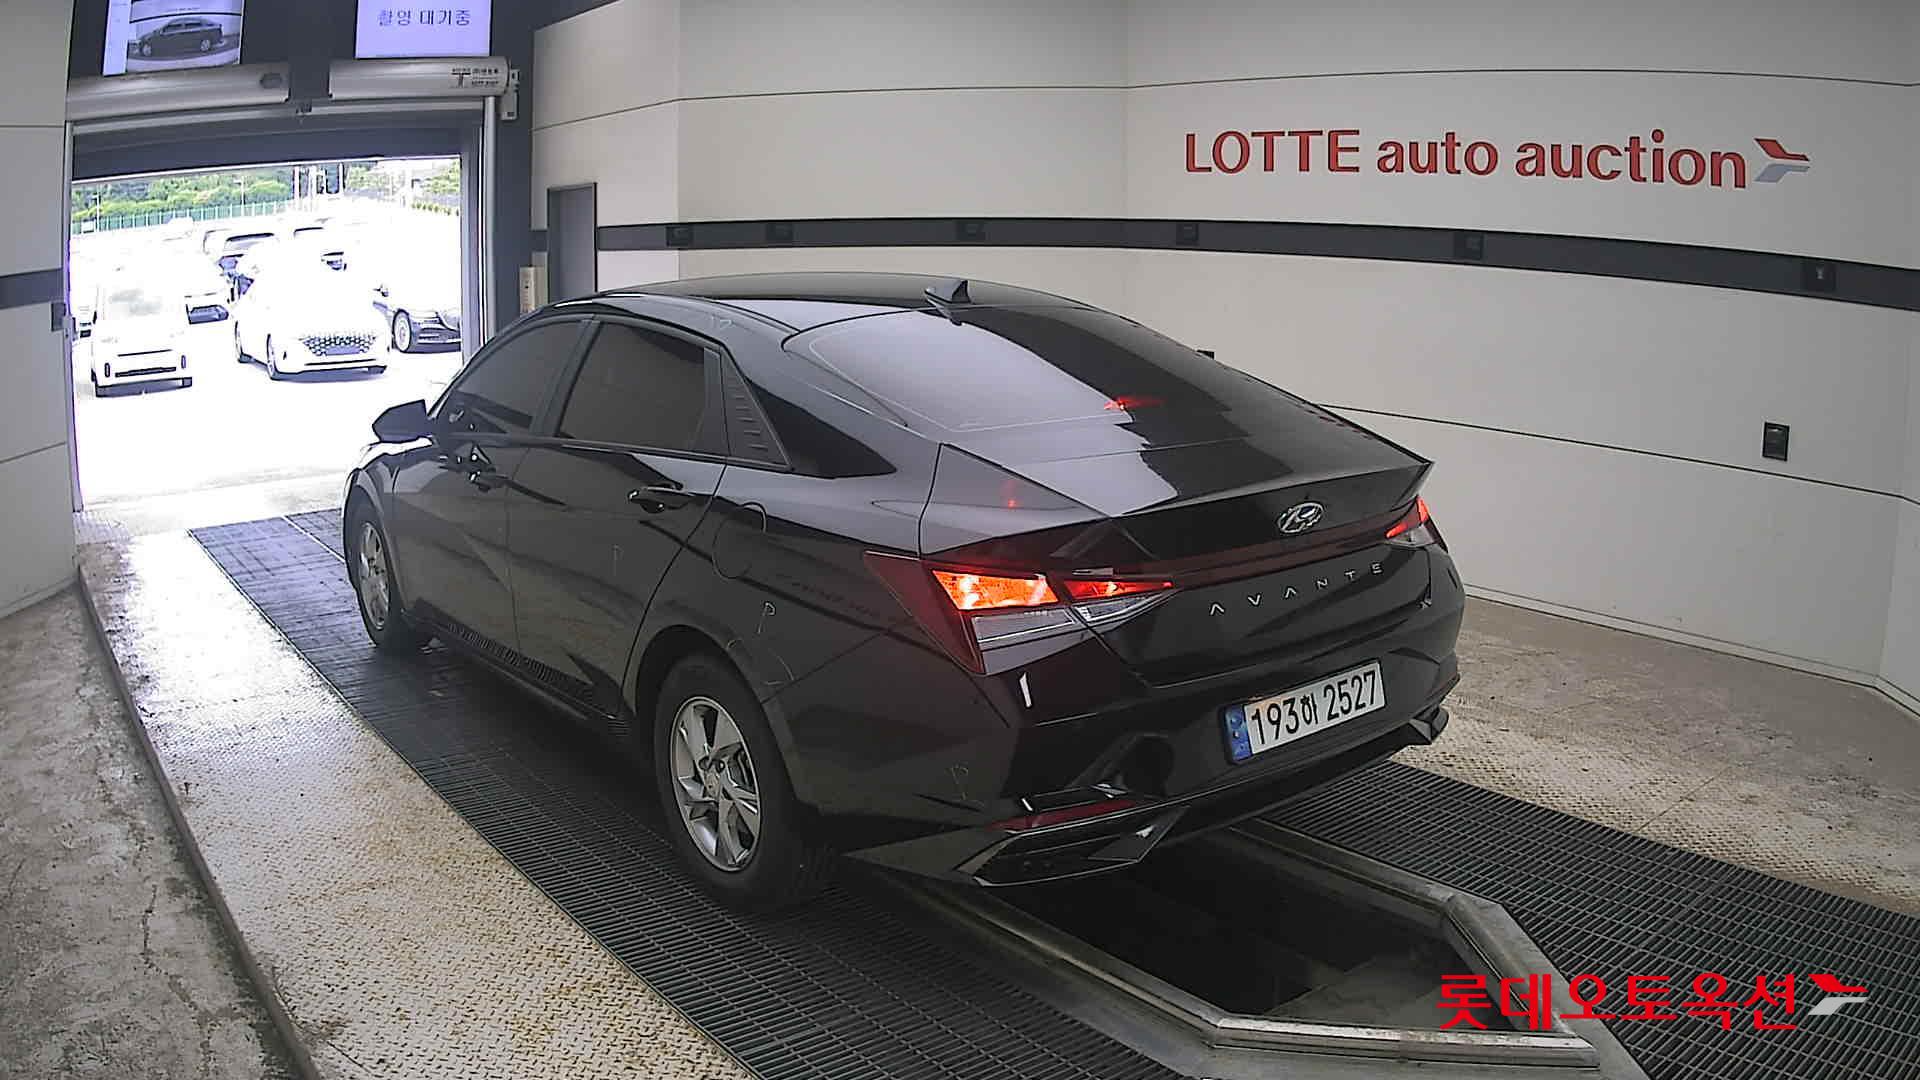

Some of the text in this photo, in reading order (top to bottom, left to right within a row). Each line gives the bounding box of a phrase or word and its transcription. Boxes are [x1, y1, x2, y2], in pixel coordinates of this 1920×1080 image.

[420, 9, 471, 26] 대기중
[1186, 129, 1746, 188] LOTTE auto auction
[1210, 562, 1383, 616] AVANTE
[1251, 669, 1376, 745] 193하 2527
